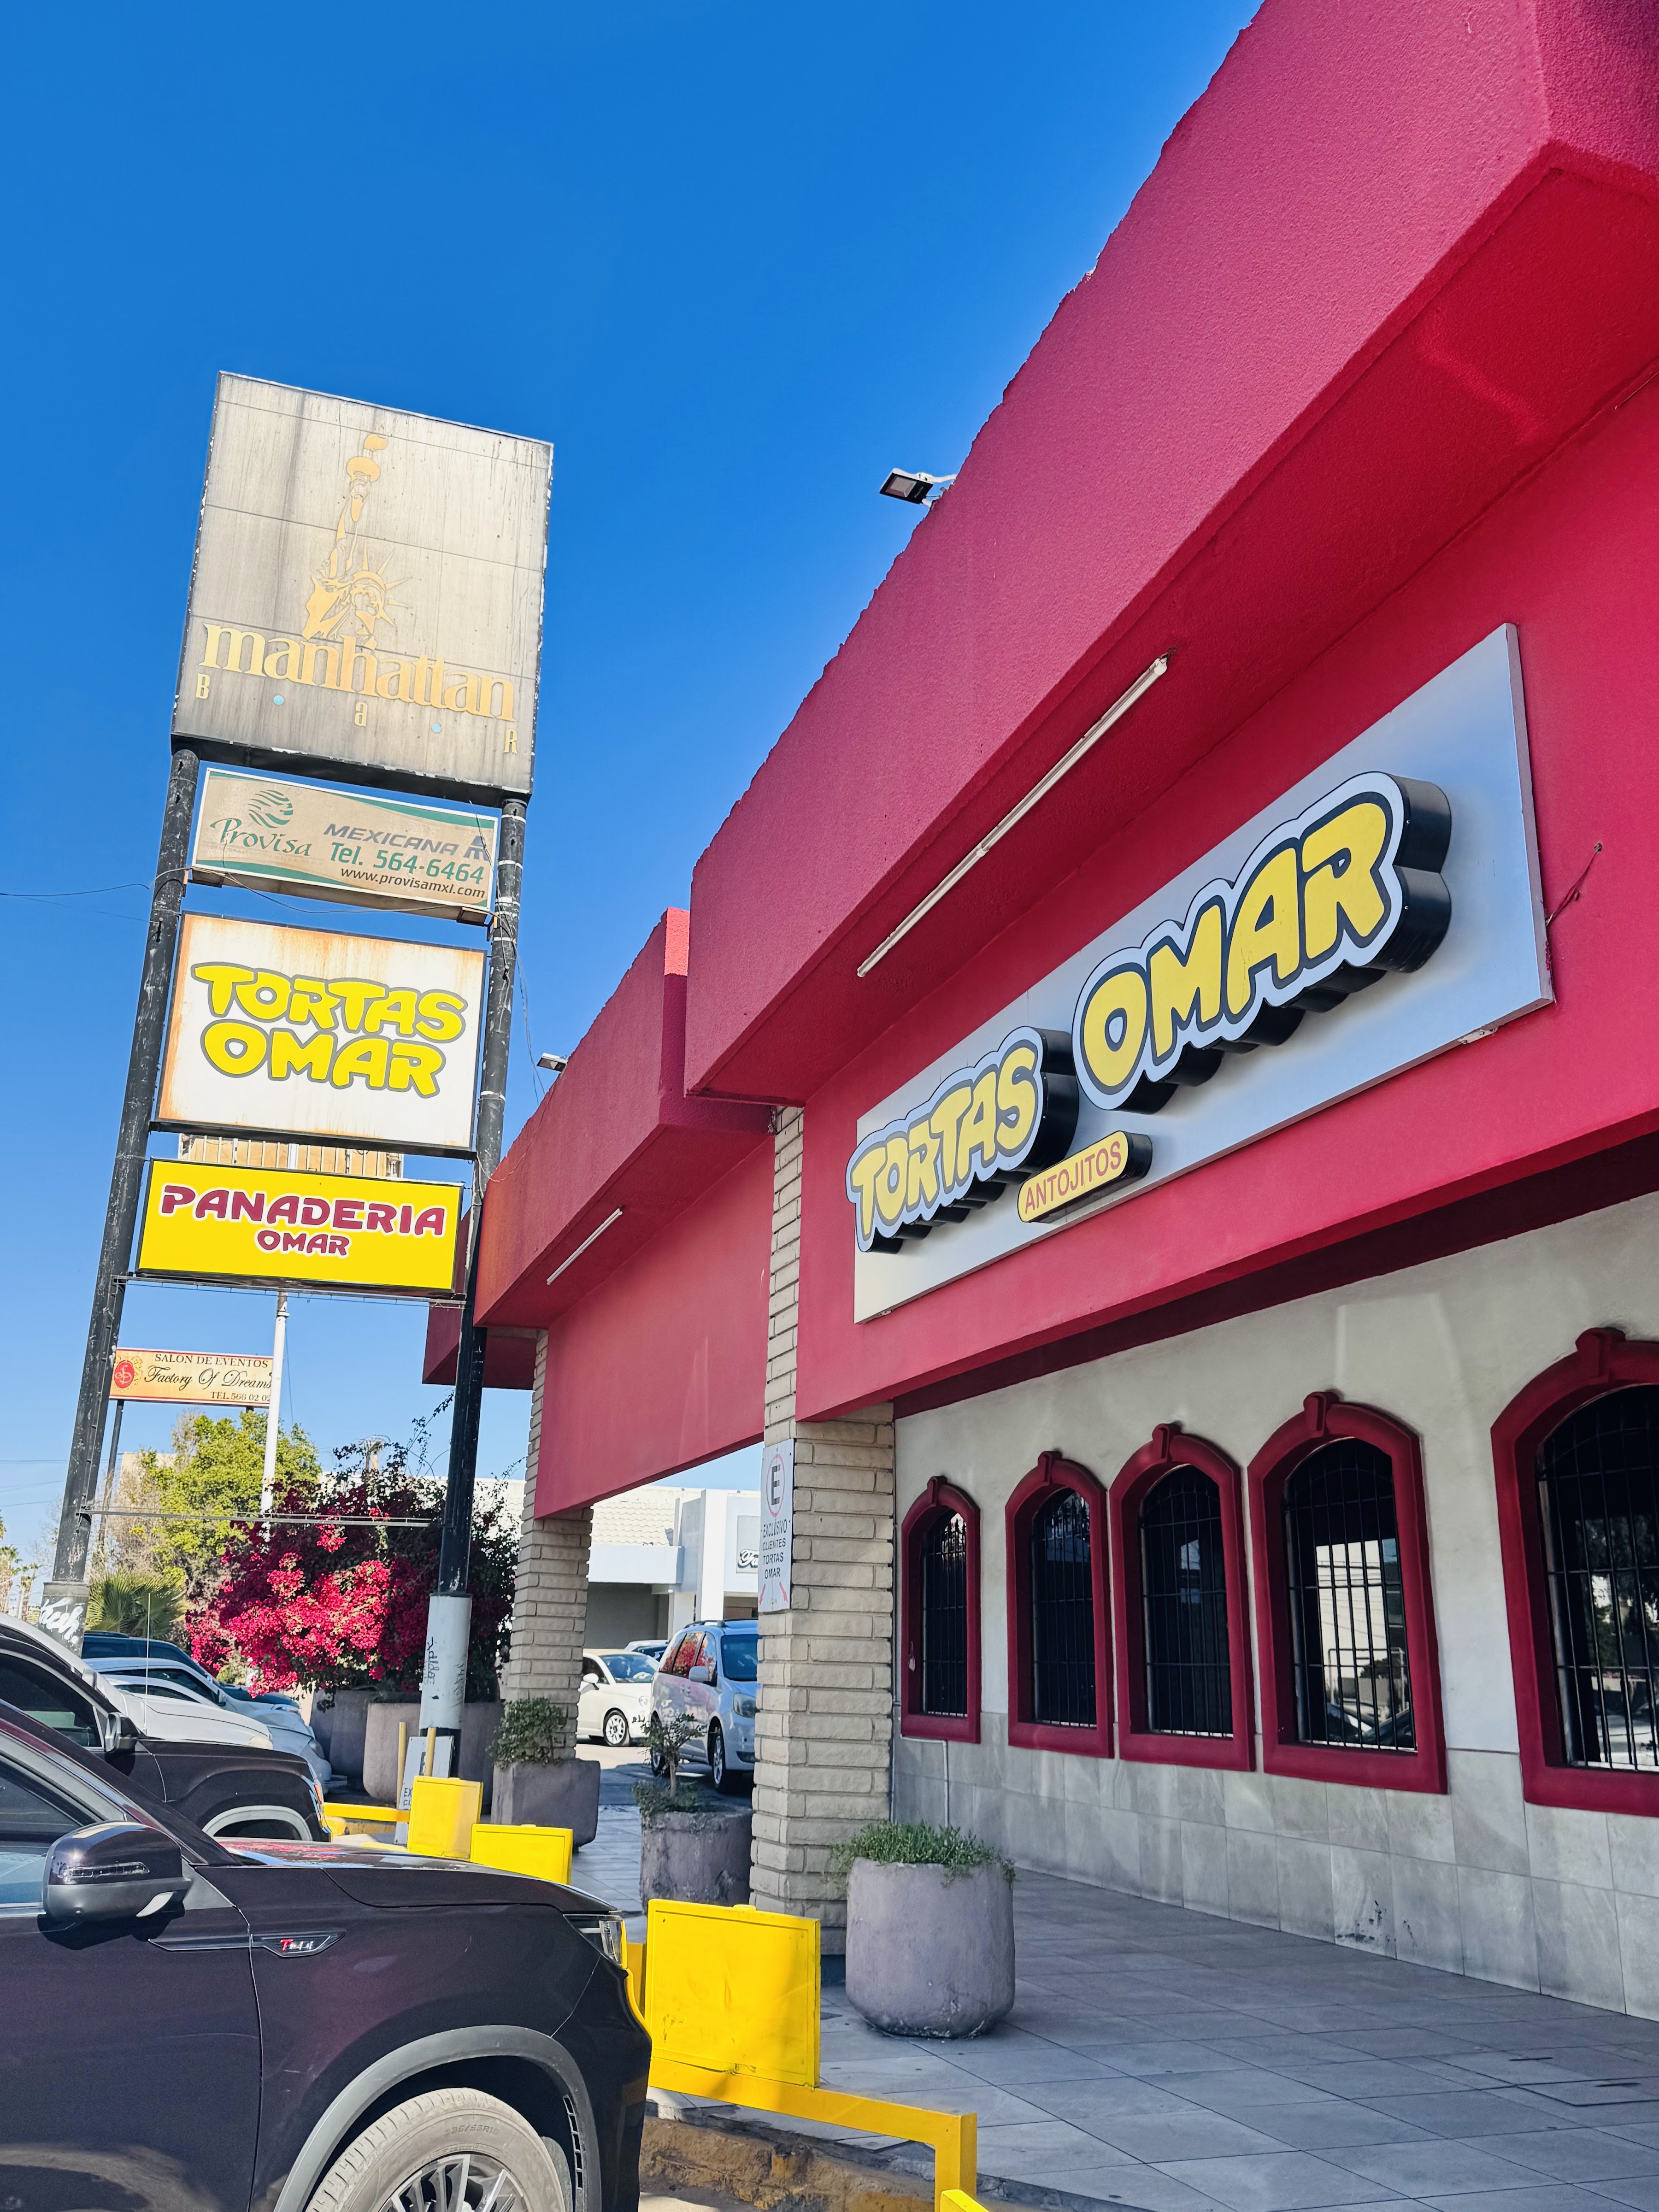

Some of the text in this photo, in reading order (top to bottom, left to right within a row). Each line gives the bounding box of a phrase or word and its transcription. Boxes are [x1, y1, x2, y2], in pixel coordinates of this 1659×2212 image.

[198, 624, 517, 722] manhattan
[210, 818, 312, 856] Provisa
[324, 823, 459, 856] MEXICANA
[330, 842, 363, 866] Tel.
[373, 849, 484, 884] 564-6464
[341, 868, 485, 898] www.provisamxl.com
[1079, 791, 1395, 1094] OMAR
[191, 962, 468, 1043] TORTAS
[200, 1019, 446, 1099] OMAR
[849, 1041, 1040, 1241] TORTAS
[1025, 1141, 1121, 1214] ANTOJITOS
[161, 1184, 445, 1235] PANADERIA
[257, 1230, 350, 1256] OMAR
[144, 1365, 193, 1391] Factory
[199, 1368, 220, 1390] Of
[155, 1353, 268, 1368] SALON DE EVENTOS
[771, 1464, 781, 1506] E
[762, 1538, 786, 1551] CLIENTES
[763, 1552, 784, 1565] TORTAS
[765, 1567, 781, 1579] OMAR
